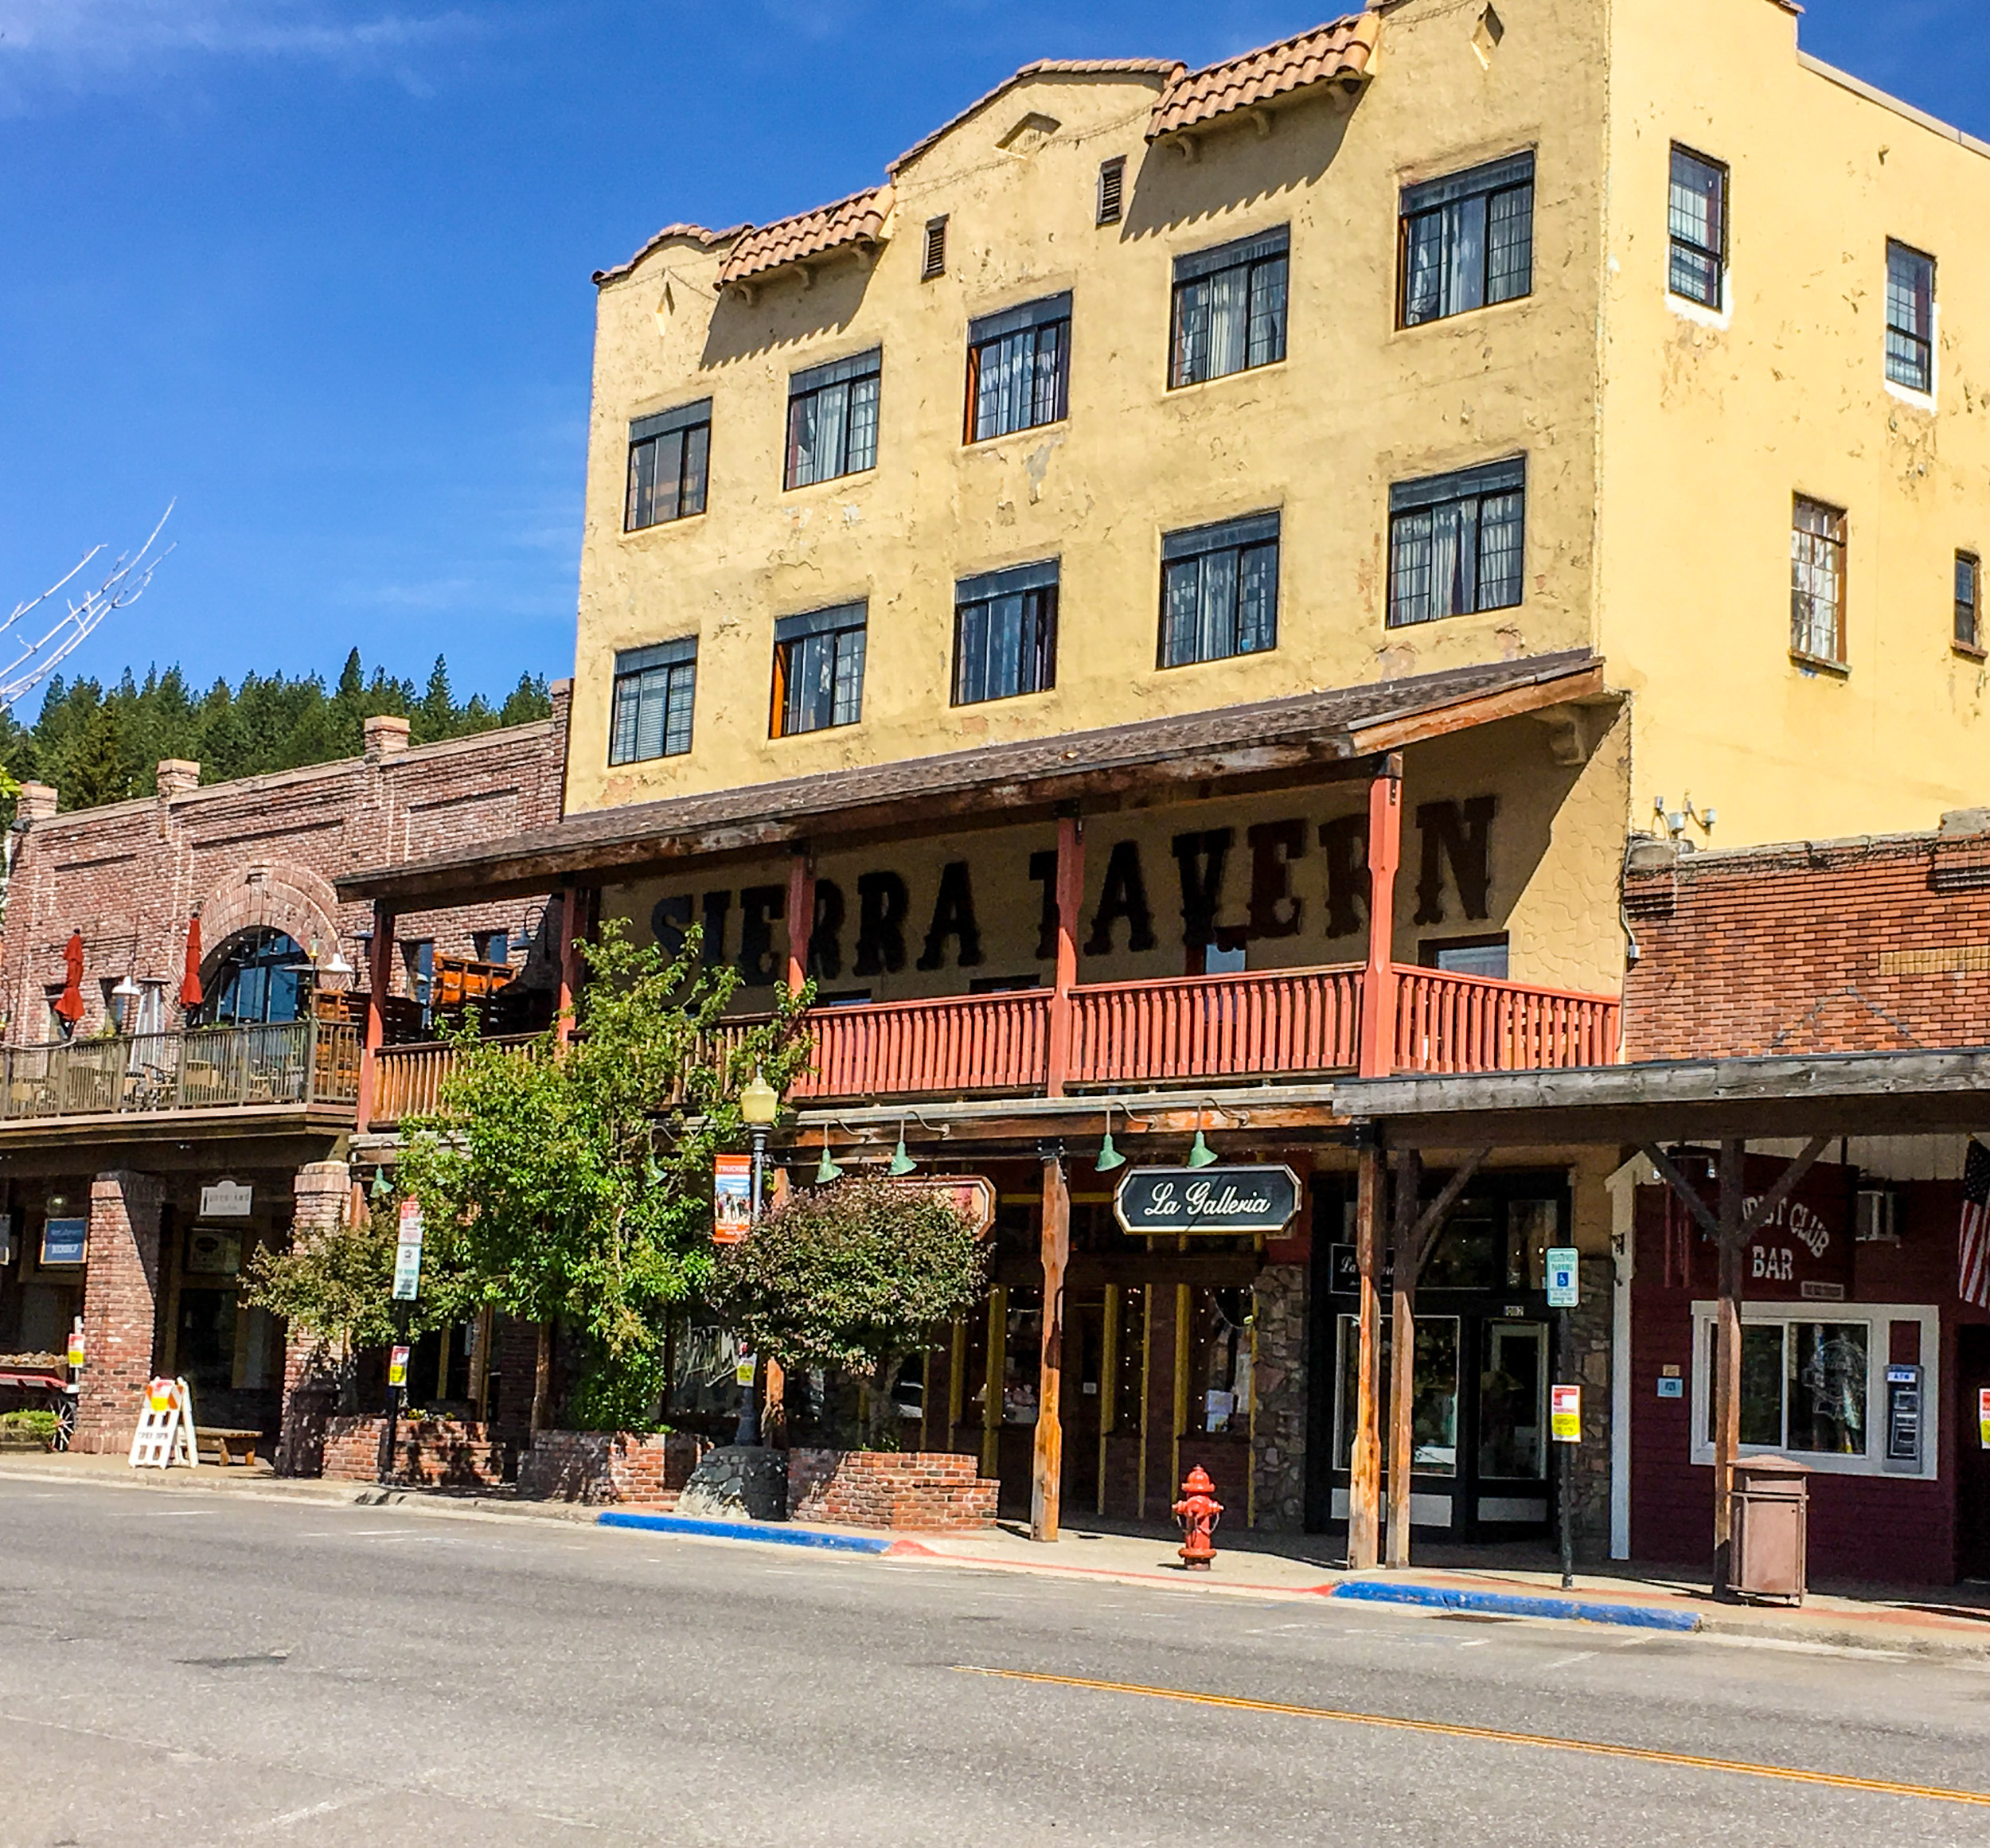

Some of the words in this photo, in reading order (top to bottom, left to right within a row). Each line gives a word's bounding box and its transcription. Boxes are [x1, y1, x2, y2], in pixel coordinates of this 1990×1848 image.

[651, 861, 981, 987] SIERRA
[1030, 795, 1496, 960] TAVERN
[1144, 1183, 1181, 1215] La
[1185, 1181, 1271, 1215] Galleria
[1789, 1203, 1830, 1257] CLUB
[1752, 1246, 1793, 1280] BAR
